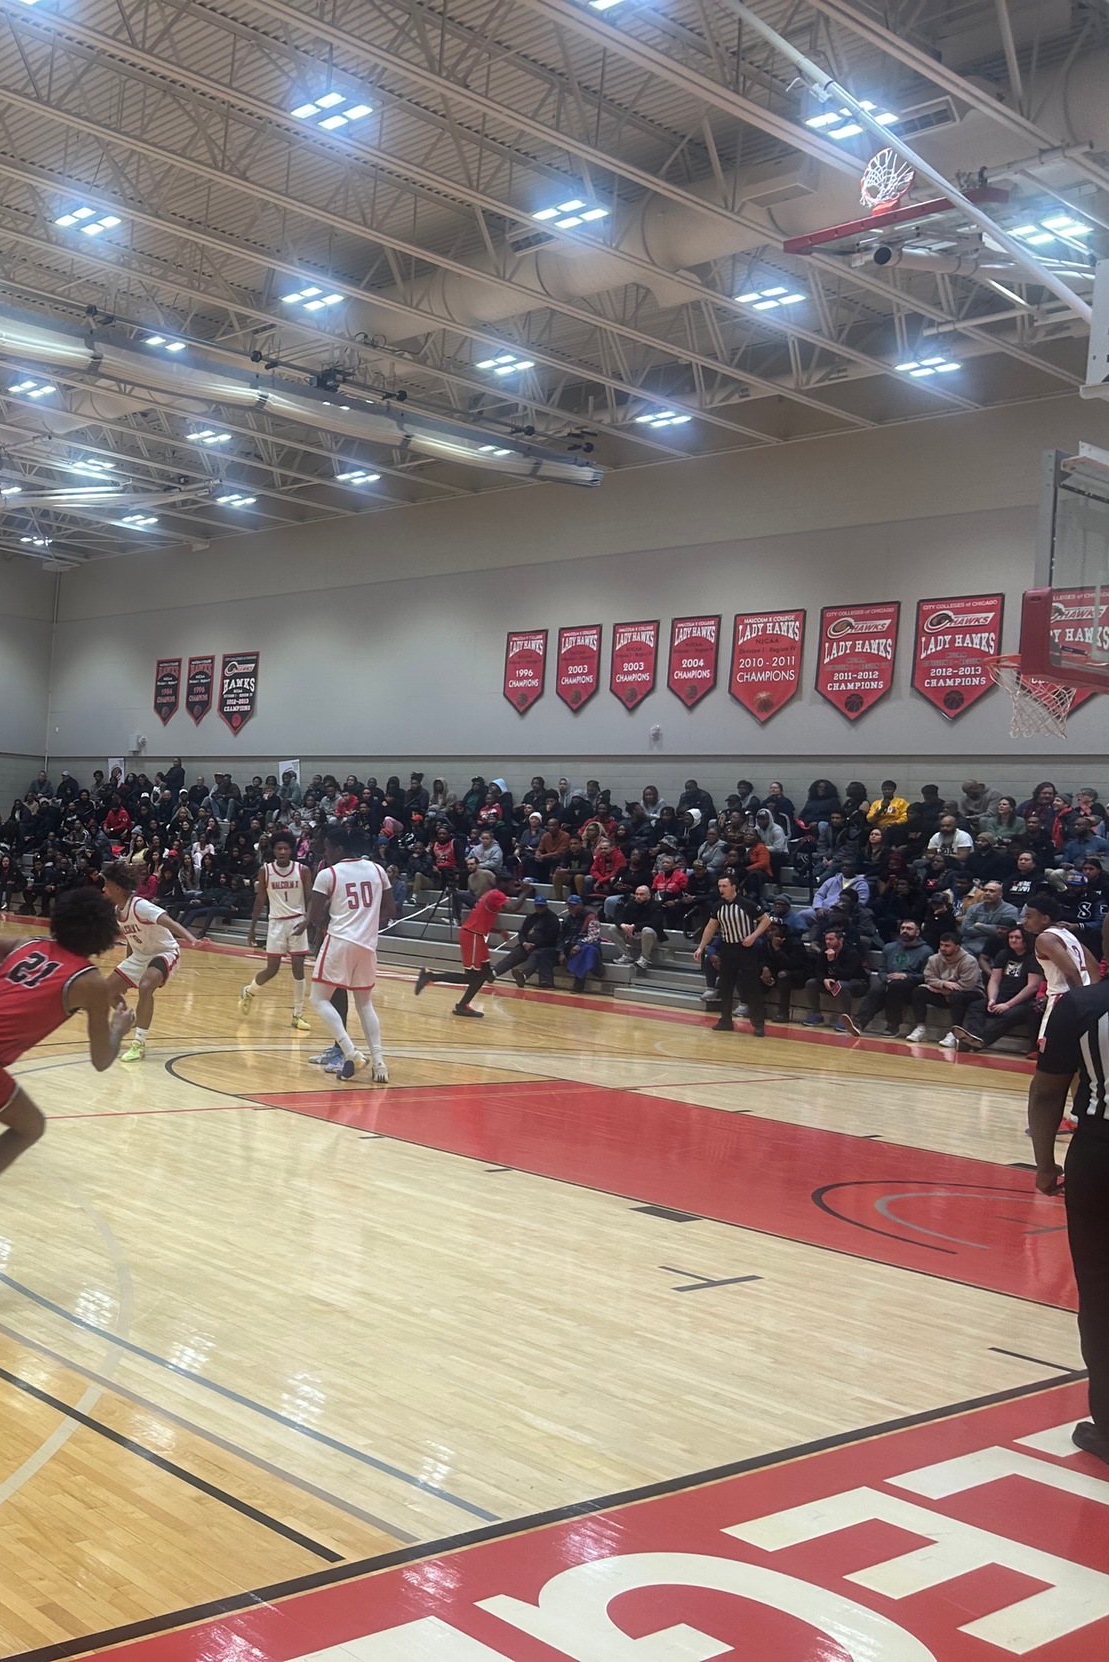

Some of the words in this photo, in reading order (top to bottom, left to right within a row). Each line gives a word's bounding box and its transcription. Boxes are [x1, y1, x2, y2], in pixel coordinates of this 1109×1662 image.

[674, 627, 691, 646] LADY
[692, 626, 715, 643] HAWKS
[738, 624, 764, 645] LADY
[766, 621, 799, 641] HAWKS
[561, 637, 575, 654] LADY
[576, 635, 597, 651] HAWKS
[616, 632, 631, 650] LADY
[632, 631, 654, 647] HAWKS
[920, 637, 952, 659] LADY
[954, 632, 995, 654] HAWKS
[509, 640, 523, 658] LADY
[523, 639, 543, 656] HAWKS
[823, 641, 852, 664] LADY
[855, 639, 892, 660] HAWKS
[623, 662, 644, 671] 2003
[681, 659, 704, 668] 2004
[739, 658, 763, 668] 2010
[772, 656, 795, 666] 2011
[515, 669, 533, 677] 1996
[567, 664, 588, 674] 2003
[674, 670, 710, 679] CHAMPIONS
[930, 666, 982, 676] 2012-2013
[561, 675, 593, 685] CHAMPIONS
[616, 673, 649, 682] CHAMPIONS
[736, 670, 795, 683] CHAMPIONS
[833, 671, 878, 680] 2011-2012
[222, 677, 255, 694] HAWKS
[508, 679, 539, 688] CHAMPIONS
[827, 681, 884, 691] CHAMPIONS
[924, 677, 986, 687] CHAMPIONS
[345, 881, 373, 909] 50
[5, 951, 64, 988] 21
